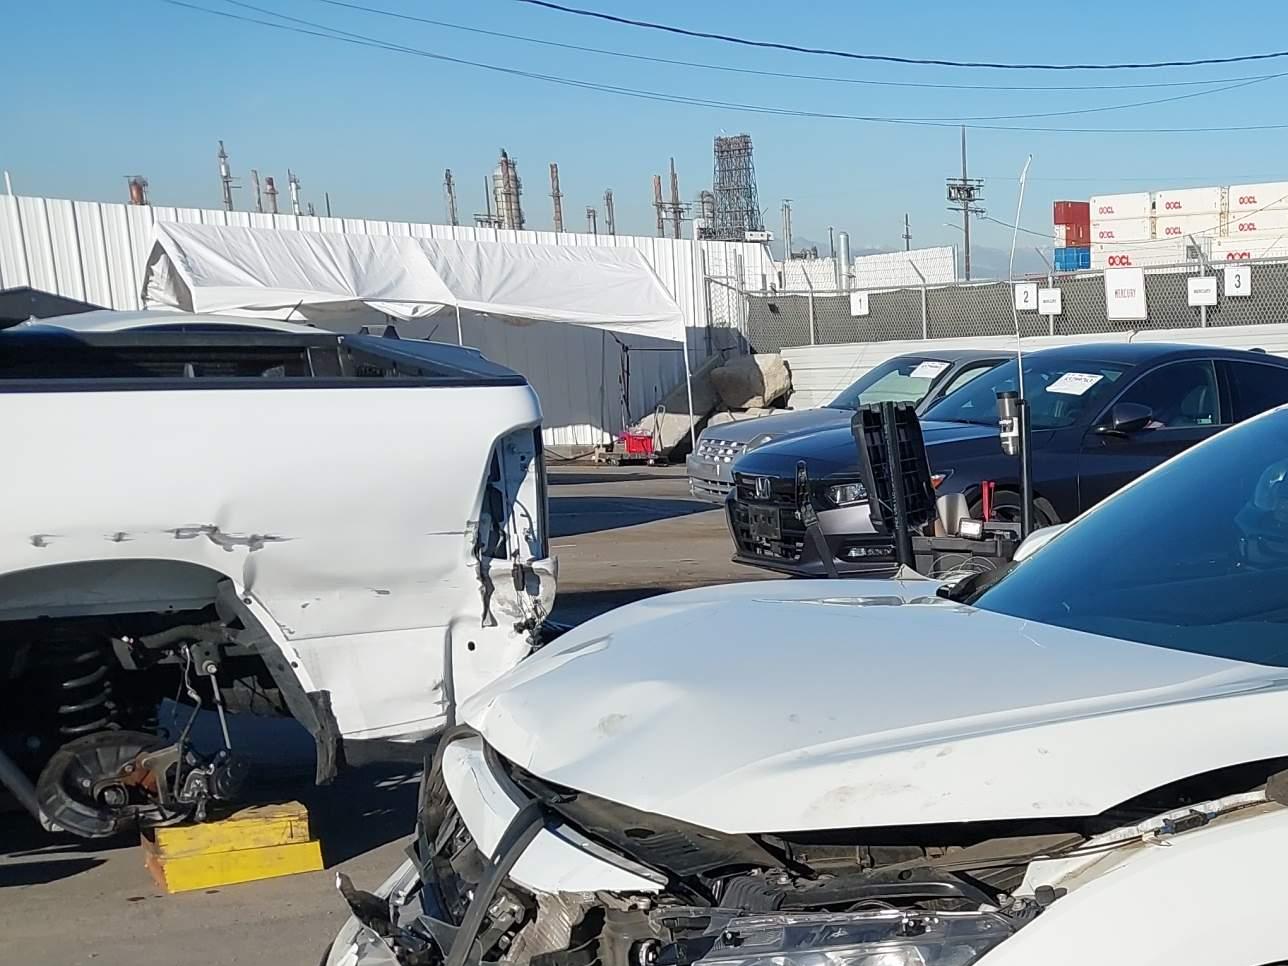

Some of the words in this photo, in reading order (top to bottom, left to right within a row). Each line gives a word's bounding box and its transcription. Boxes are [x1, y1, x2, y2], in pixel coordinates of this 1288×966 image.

[1239, 196, 1257, 204] OOCL
[1165, 201, 1182, 209] OOCL
[1165, 227, 1182, 235] OOCL
[1239, 223, 1256, 231] OOCL
[1108, 255, 1131, 266] OOCL
[1234, 274, 1241, 288] 3
[1023, 290, 1029, 303] 2
